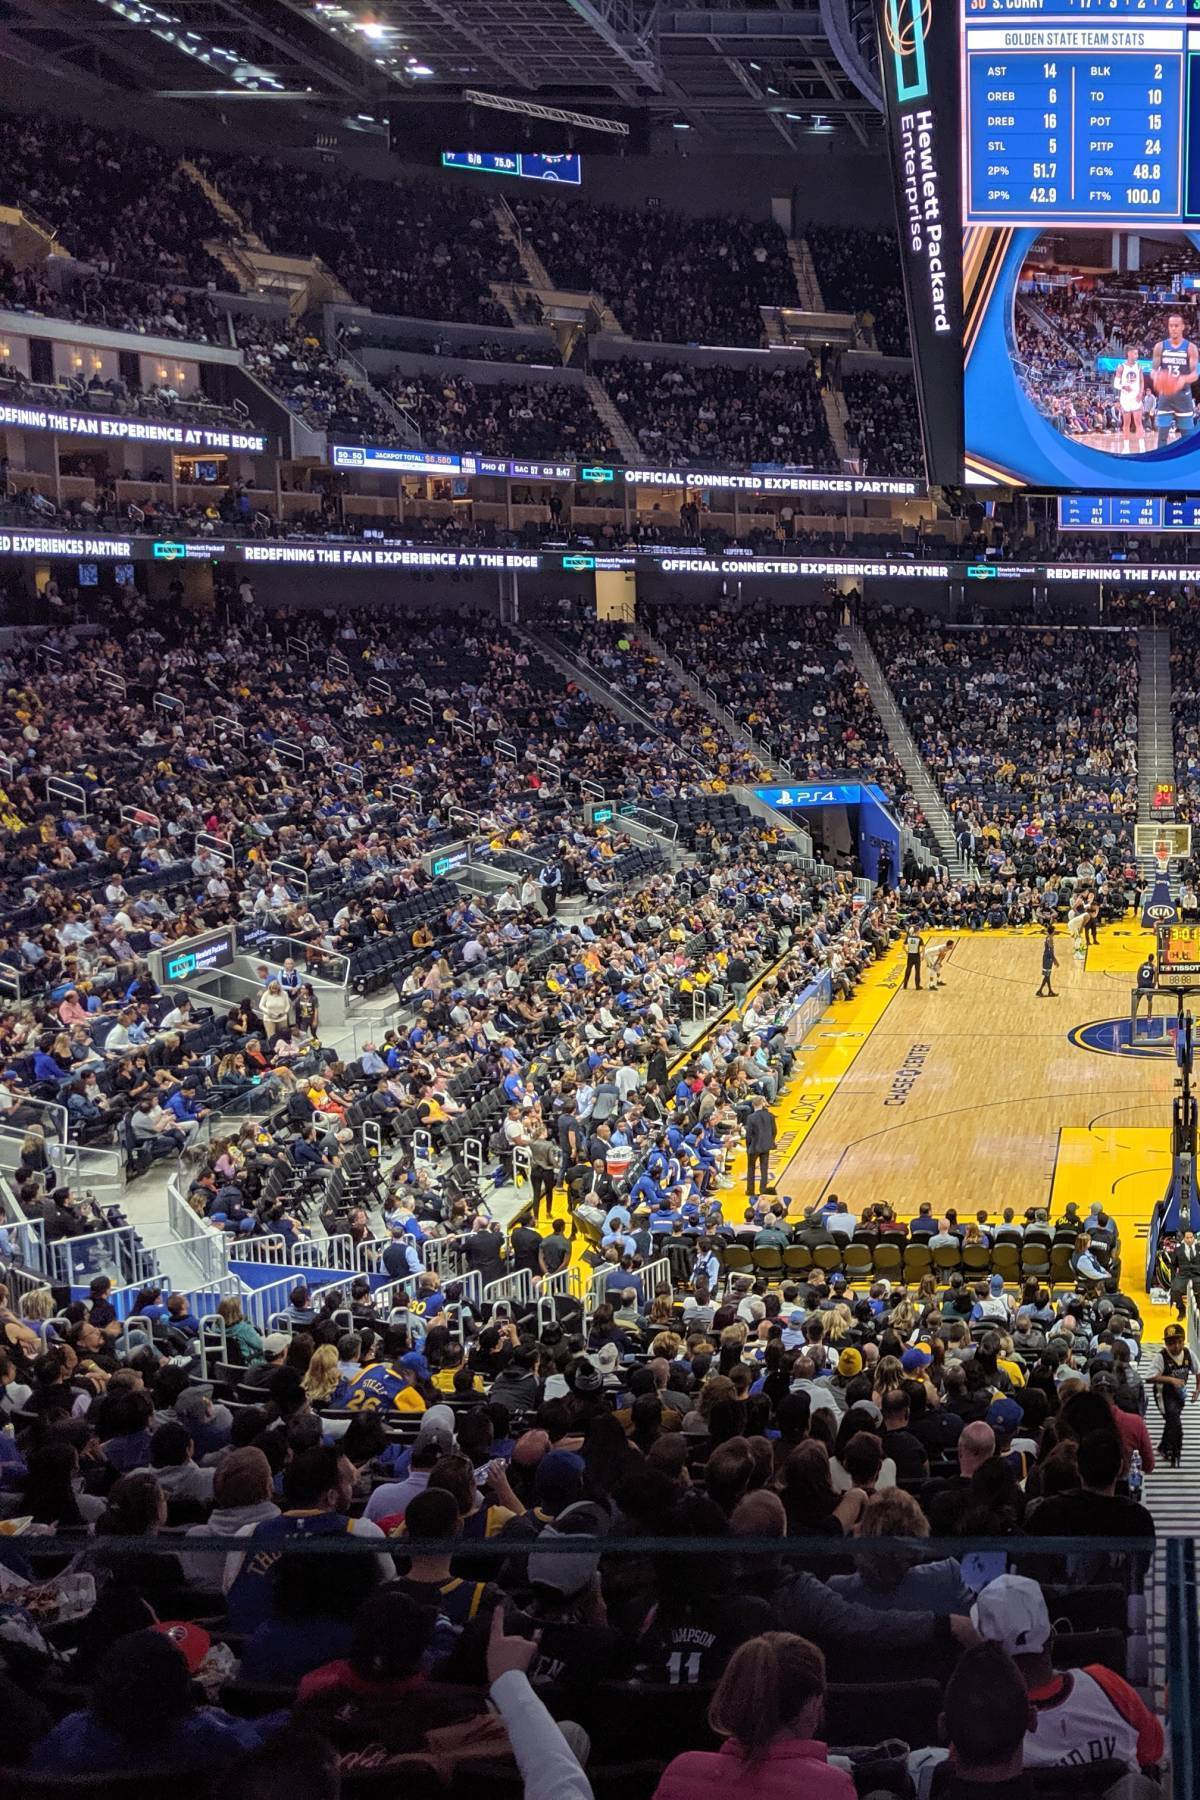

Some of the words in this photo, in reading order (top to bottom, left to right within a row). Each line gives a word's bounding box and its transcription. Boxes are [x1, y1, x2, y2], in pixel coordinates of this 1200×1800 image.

[1004, 32, 1044, 46] GOLDEN
[1047, 32, 1078, 46] STATE
[1080, 32, 1109, 46] TEAM
[1112, 32, 1144, 46] STATS
[987, 66, 1007, 76] AST
[1044, 63, 1057, 79] 14
[1090, 66, 1110, 76] BLK
[1154, 64, 1163, 79] 2
[987, 92, 1015, 101] OREB
[1049, 88, 1057, 104] 6
[1090, 92, 1104, 101] TO
[1148, 89, 1162, 104] 10
[988, 117, 1014, 126] DREB
[1044, 113, 1057, 129] 16
[1090, 117, 1111, 126] POT
[1148, 115, 1162, 130] 15
[988, 142, 1006, 151] STL
[1049, 138, 1056, 154] 5
[1090, 142, 1113, 151] PITP
[1145, 139, 1161, 155] 24
[917, 110, 940, 220] Hewlett
[988, 166, 1009, 176] 2P%
[1034, 163, 1056, 178] 51.7
[1090, 167, 1113, 176] FG%
[1133, 164, 1160, 179] 48.8
[901, 114, 923, 251] Enterprise
[988, 191, 1009, 200] 3P%
[1030, 187, 1056, 203] 42.9
[1090, 191, 1111, 201] FT%
[1126, 189, 1160, 204] 100.0
[927, 224, 950, 332] Packard
[1168, 365, 1180, 377] 13
[48, 415, 69, 431] THE
[70, 417, 98, 434] FAN
[101, 421, 182, 442] EXPERIENCE
[185, 430, 202, 444] AT
[205, 432, 230, 447] THE
[232, 434, 263, 450] EDGE
[481, 463, 496, 471] PHO
[498, 463, 506, 472] 47
[625, 471, 684, 484] OFFICIAL
[687, 474, 760, 488] CONNECTED
[764, 478, 852, 492] EXPERIENCES
[855, 481, 915, 494] PARTNER
[13, 537, 84, 554] EXPERIENCES
[85, 541, 130, 556] PARTNER
[245, 548, 315, 561] REDEFINING
[317, 550, 340, 562] THE
[344, 550, 372, 563] FAN
[375, 552, 455, 565] EXPERIENCE
[459, 554, 477, 566] AT
[479, 555, 503, 566] THE
[507, 556, 538, 567] EDGE
[662, 559, 719, 572] OFFICIAL
[722, 562, 798, 574] CONNECTED
[801, 563, 886, 576] EXPERIENCES
[889, 565, 948, 577] PARTNER
[1047, 569, 1120, 581] REDEFINING
[1124, 569, 1147, 581] THE
[1150, 569, 1176, 581] FAN
[797, 791, 834, 802] PS4
[1152, 908, 1170, 916] KIA
[884, 1078, 915, 1106] CHASE
[902, 1044, 932, 1068] CENTER
[408, 1300, 427, 1315] 30
[666, 1652, 702, 1684] 11
